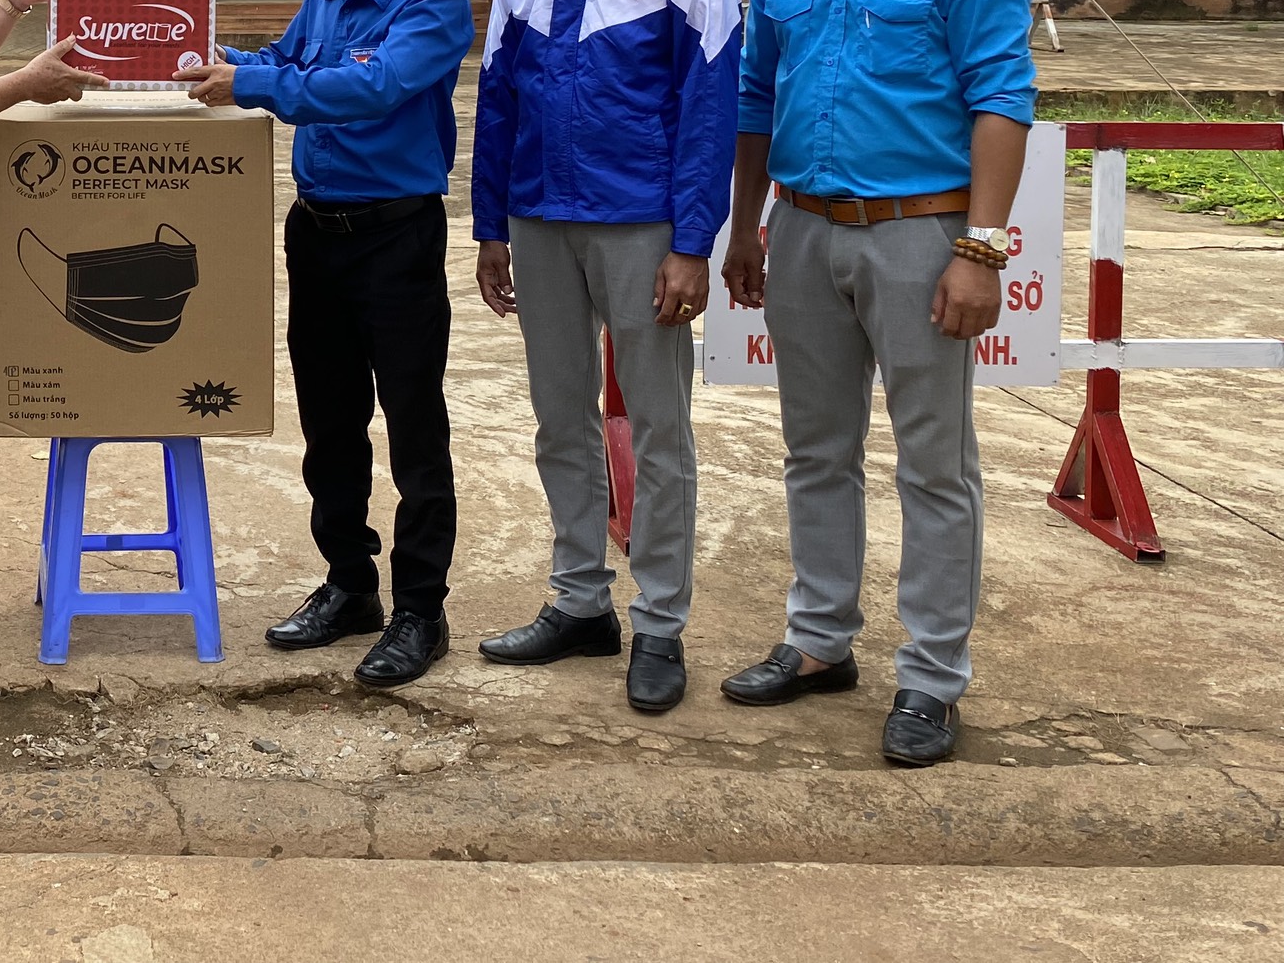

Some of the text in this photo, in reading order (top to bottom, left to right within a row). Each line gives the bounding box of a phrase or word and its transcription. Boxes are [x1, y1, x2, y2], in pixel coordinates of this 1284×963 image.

[180, 54, 197, 70] HIGH
[72, 139, 191, 152] KHẨU TRANG Y TẾ
[72, 155, 245, 175] OCEANMASK
[72, 178, 190, 190] PERFECT MASK
[1007, 270, 1043, 311] SỞ
[22, 366, 63, 374] Màu xanh
[22, 395, 41, 403] Màu
[195, 394, 224, 406] 4 Lớp
[8, 411, 19, 419] Số
[63, 411, 79, 420] hộp
